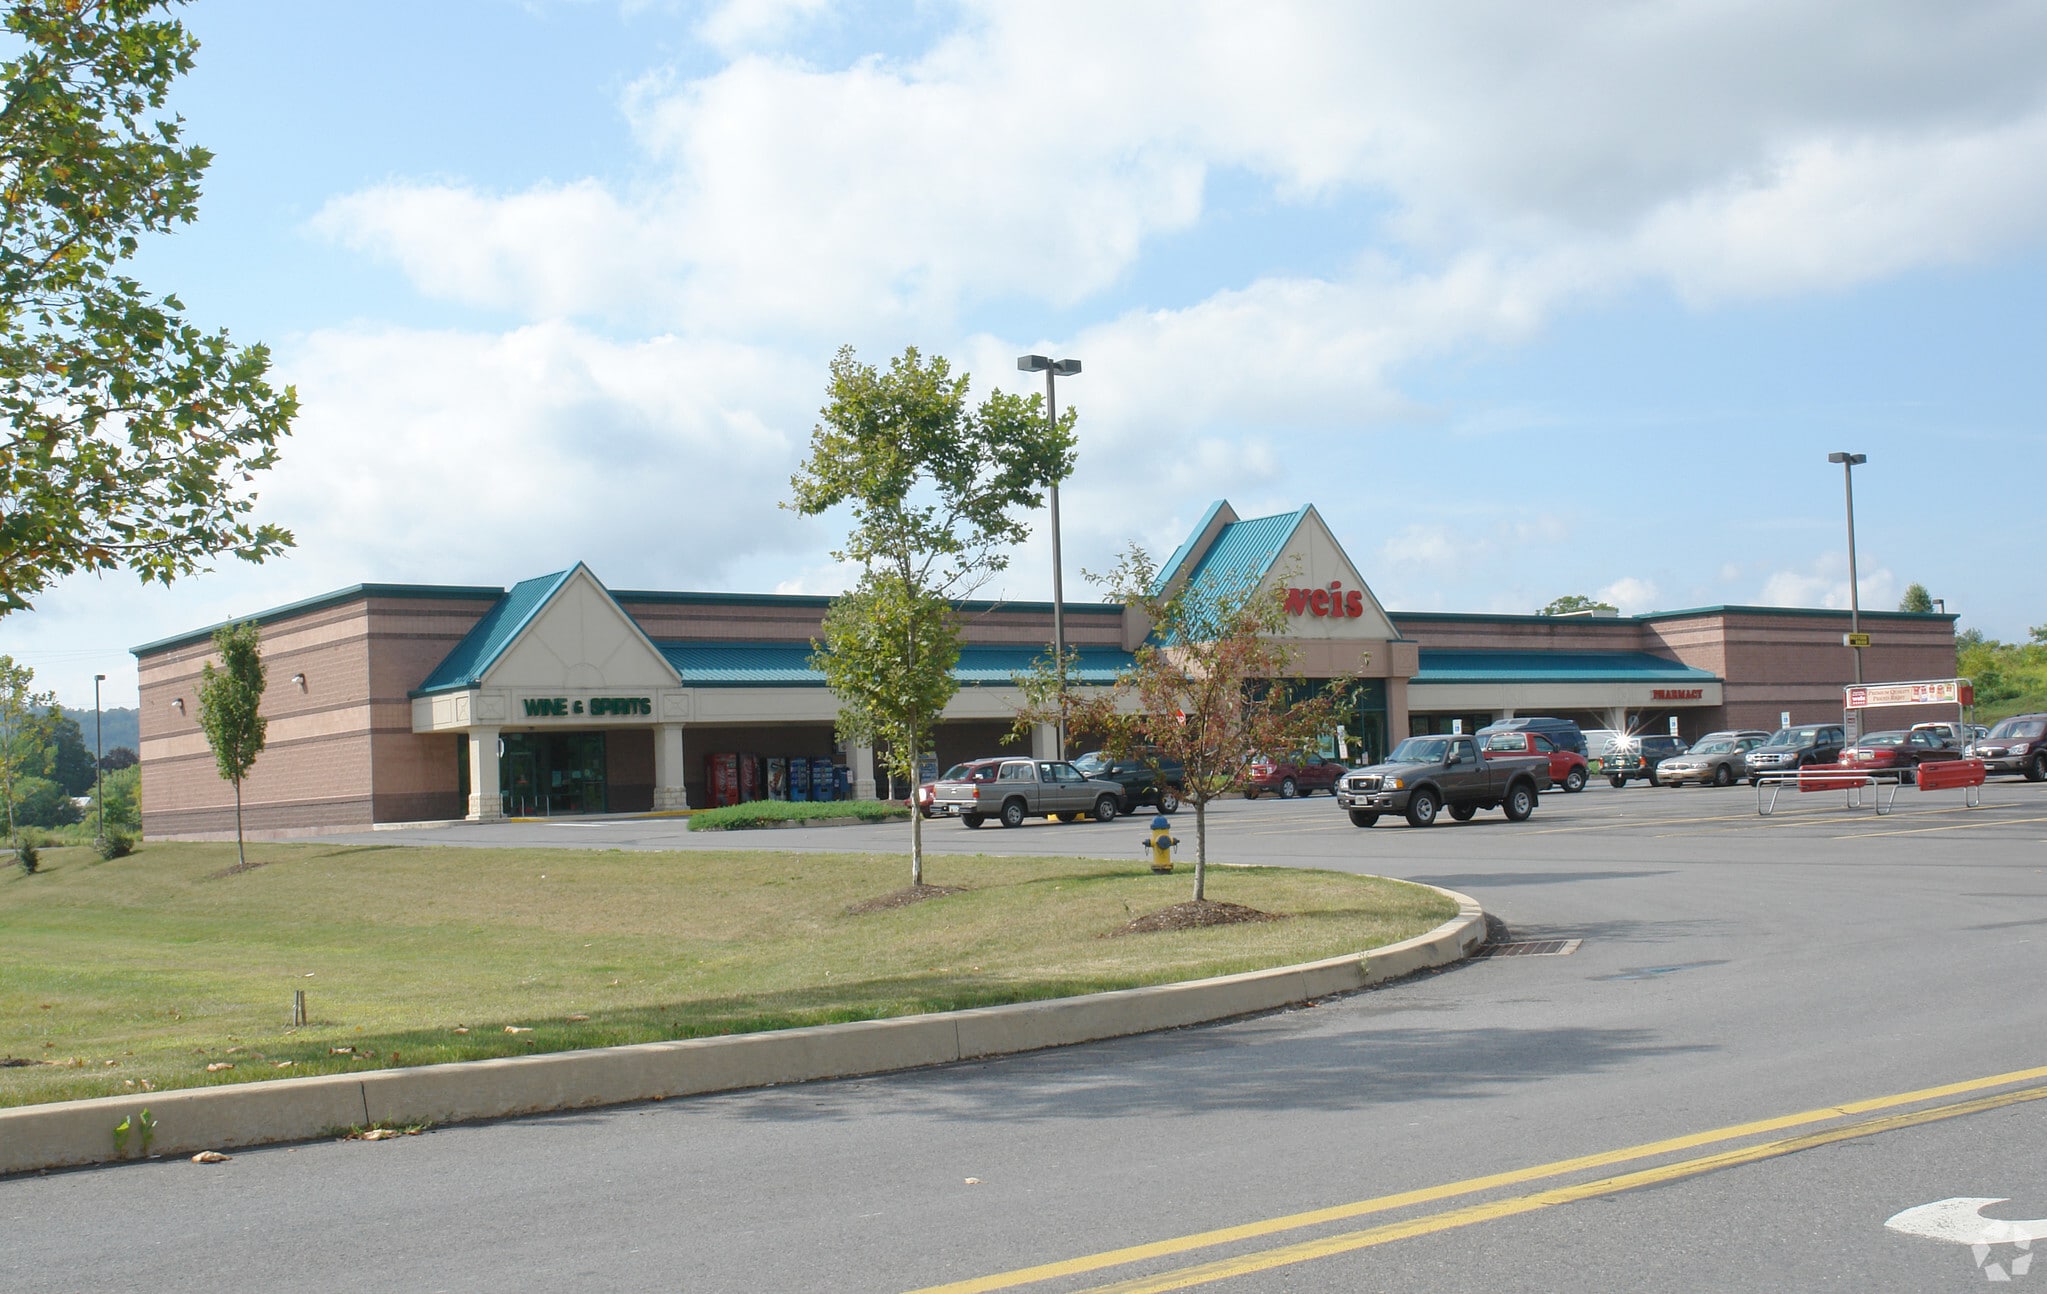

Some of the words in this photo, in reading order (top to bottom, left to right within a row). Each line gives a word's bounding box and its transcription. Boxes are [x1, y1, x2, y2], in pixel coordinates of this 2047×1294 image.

[1275, 581, 1363, 617] weis
[1652, 689, 1703, 699] PHARMACY
[524, 698, 568, 716] WINE
[574, 700, 584, 714] &
[590, 697, 651, 715] SPIRITS
